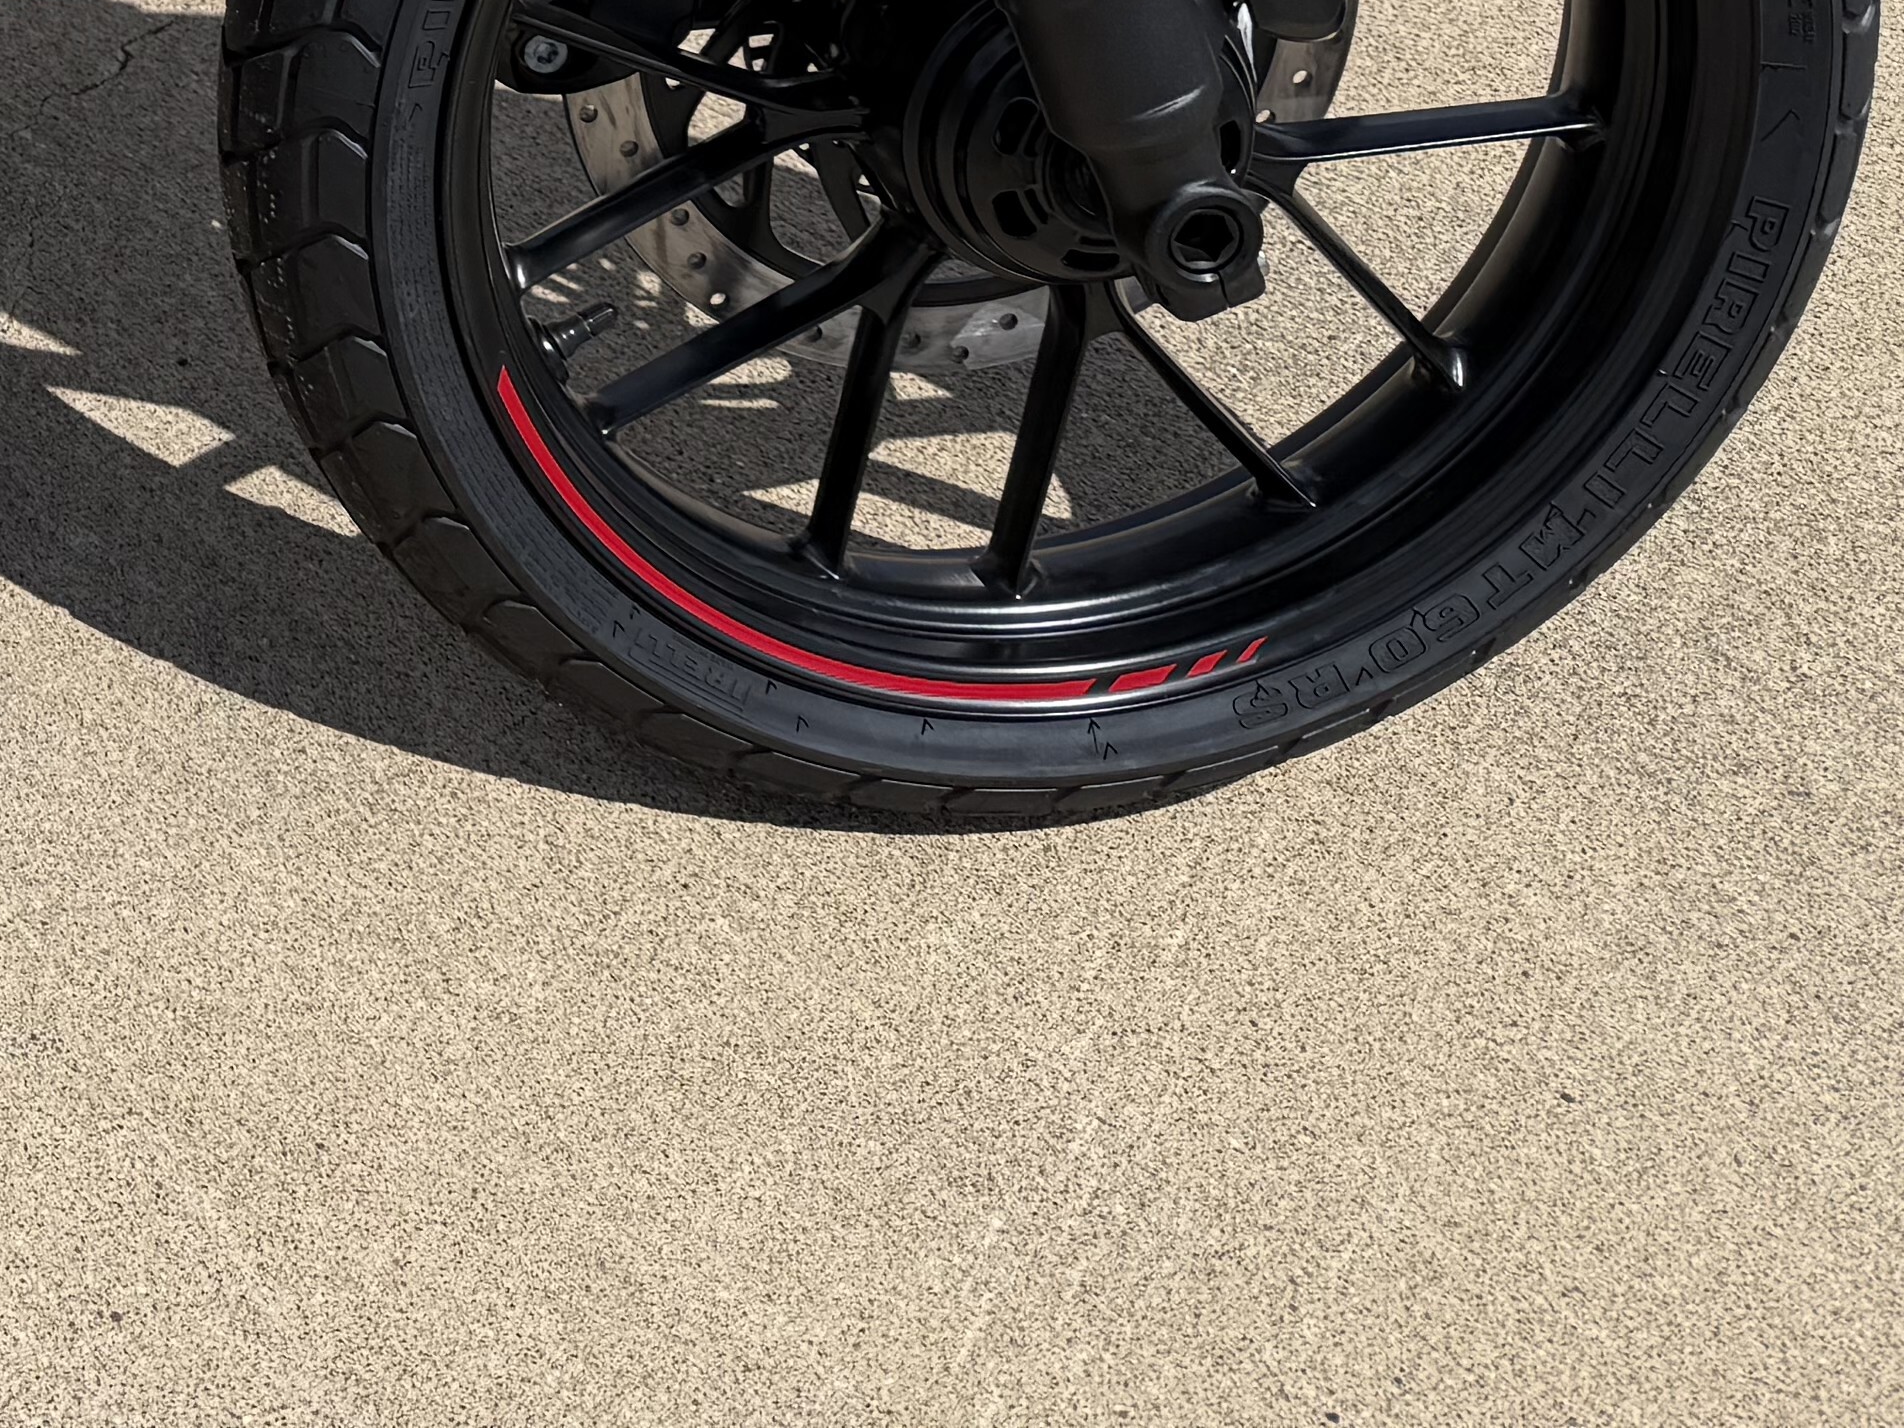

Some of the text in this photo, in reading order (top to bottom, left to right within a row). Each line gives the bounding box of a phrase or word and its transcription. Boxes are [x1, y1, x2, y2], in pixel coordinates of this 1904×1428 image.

[1230, 194, 1794, 735] PIRELLI MT60 RS
